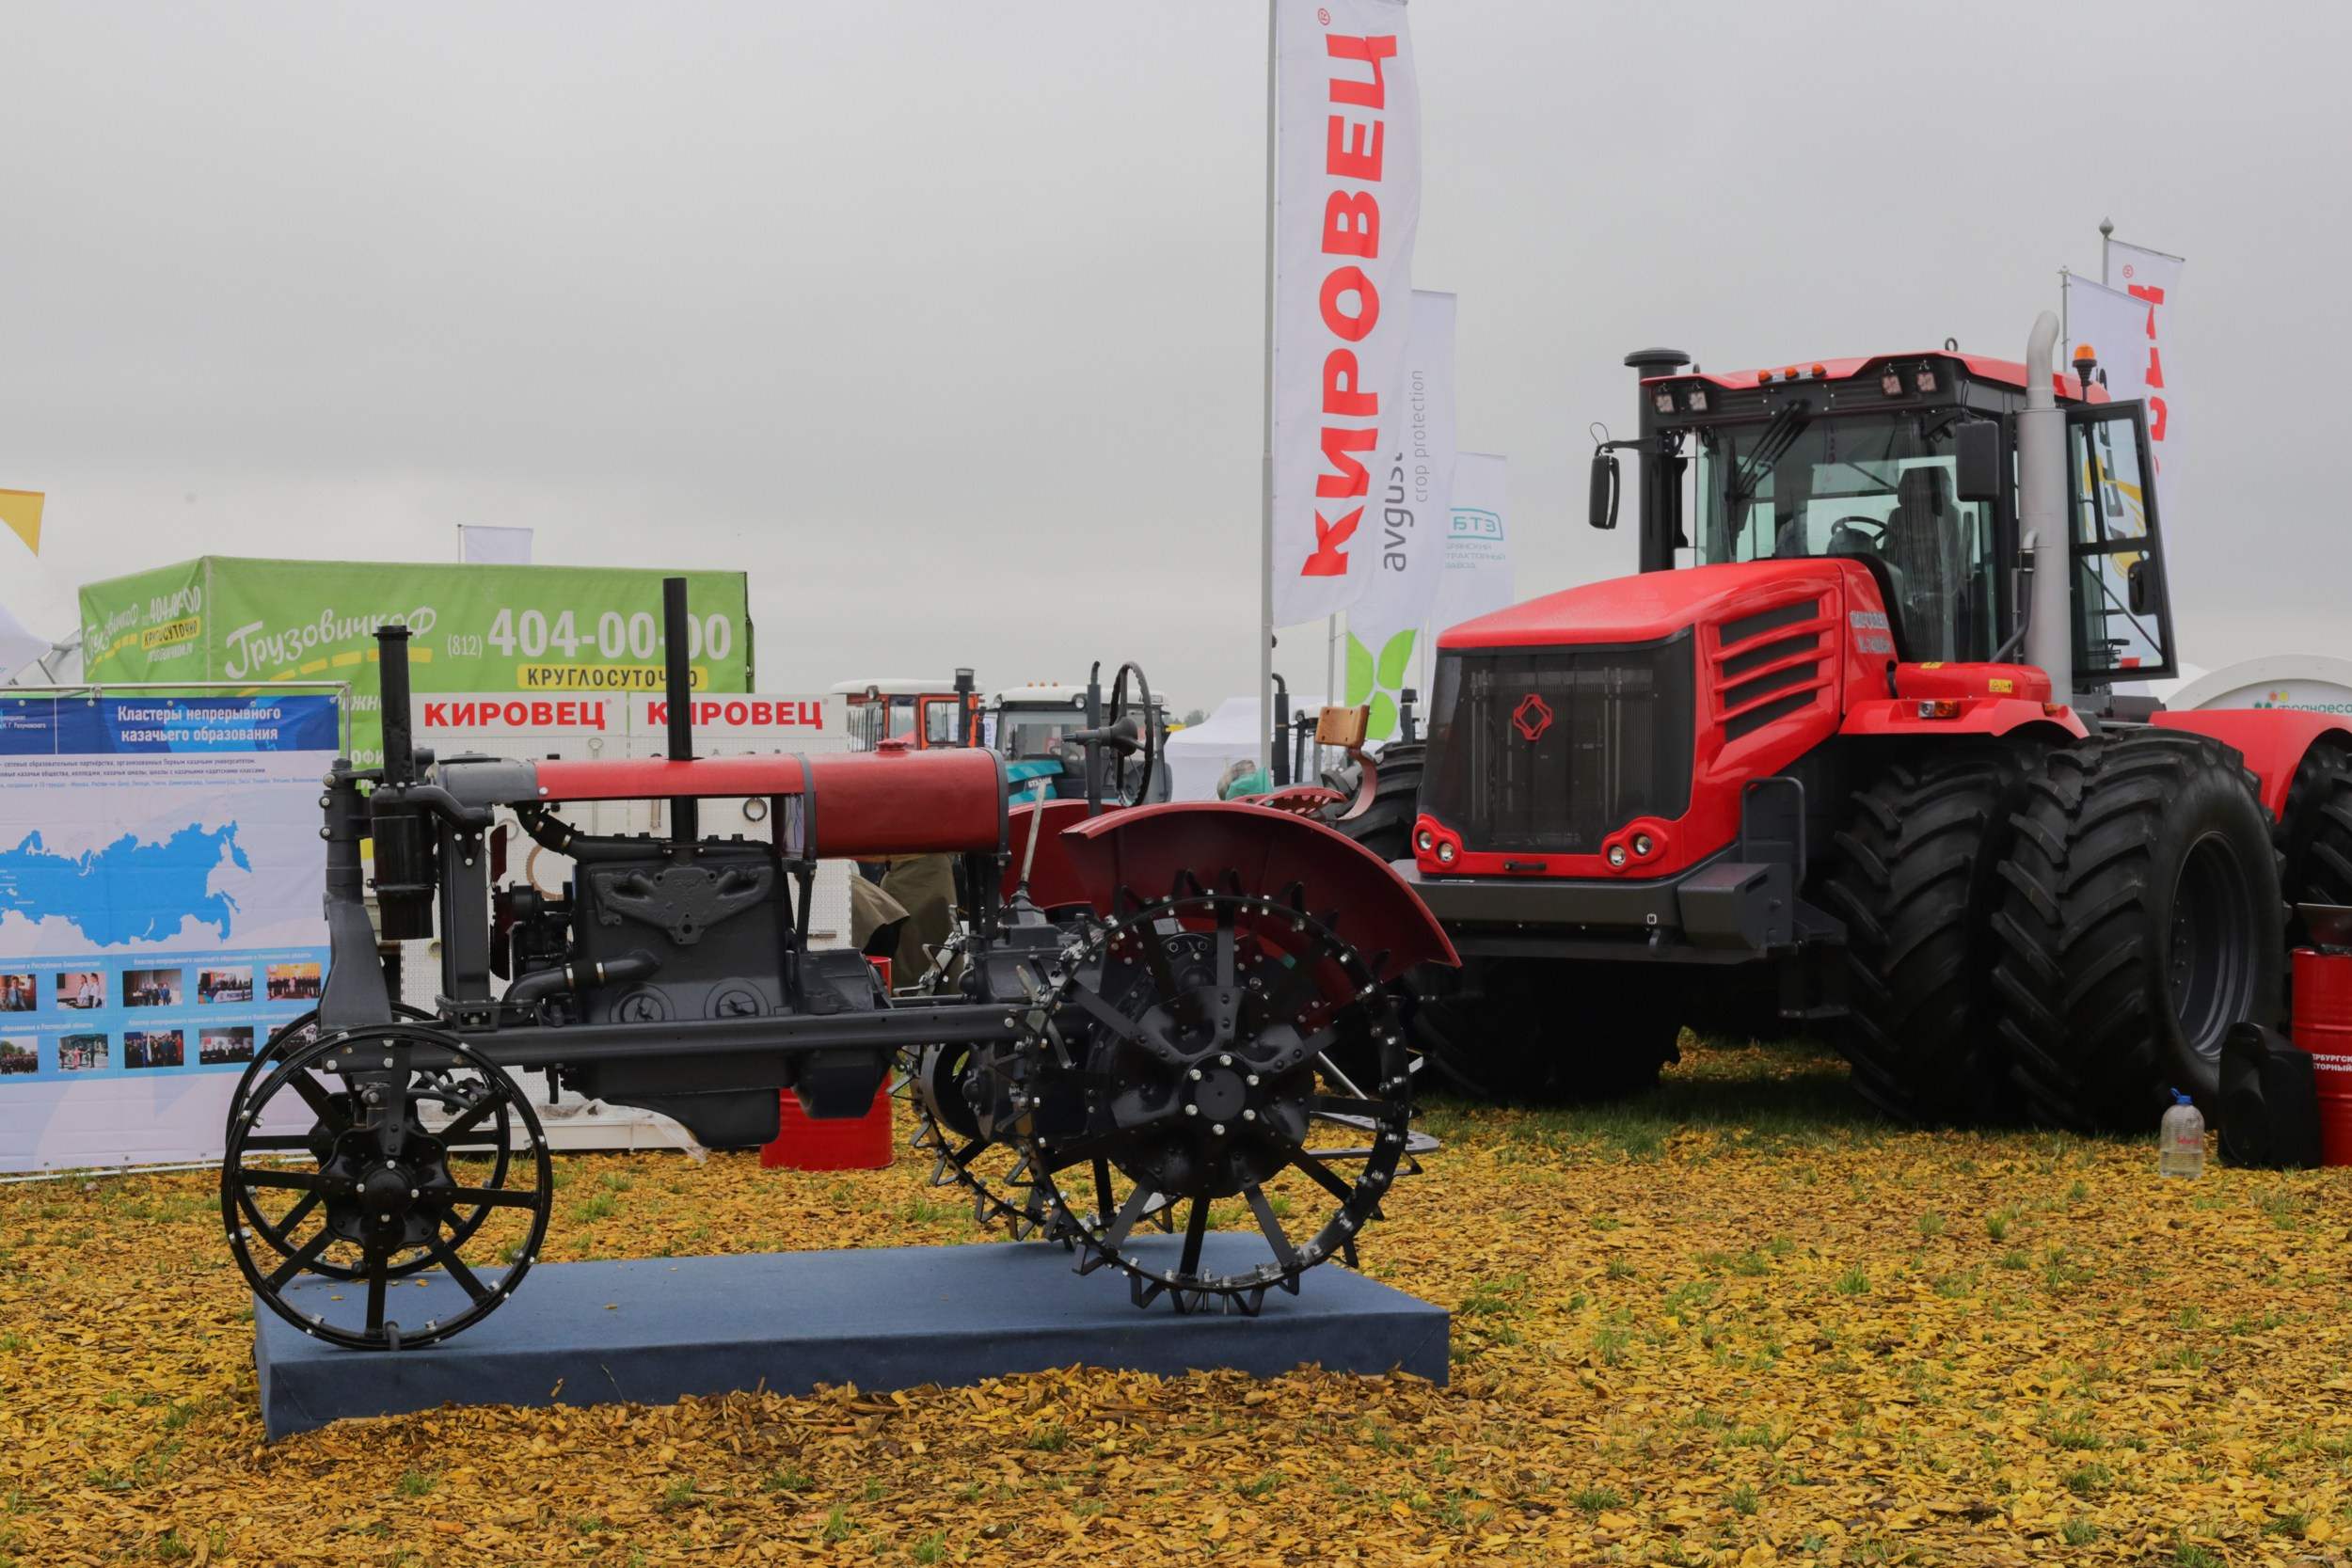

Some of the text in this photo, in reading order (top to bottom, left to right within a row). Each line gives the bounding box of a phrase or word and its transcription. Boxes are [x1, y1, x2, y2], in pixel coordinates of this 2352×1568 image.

[1300, 33, 1397, 577] КИРОВЕЦ
[1408, 370, 1430, 502] crop protection
[447, 633, 483, 658] (812)
[527, 667, 698, 687] КРУГЛОСУТОЧО
[118, 705, 281, 724] Кластеры непрерывного
[424, 701, 605, 730] КИРОВЕЦ
[121, 725, 278, 744] казачьего образования
